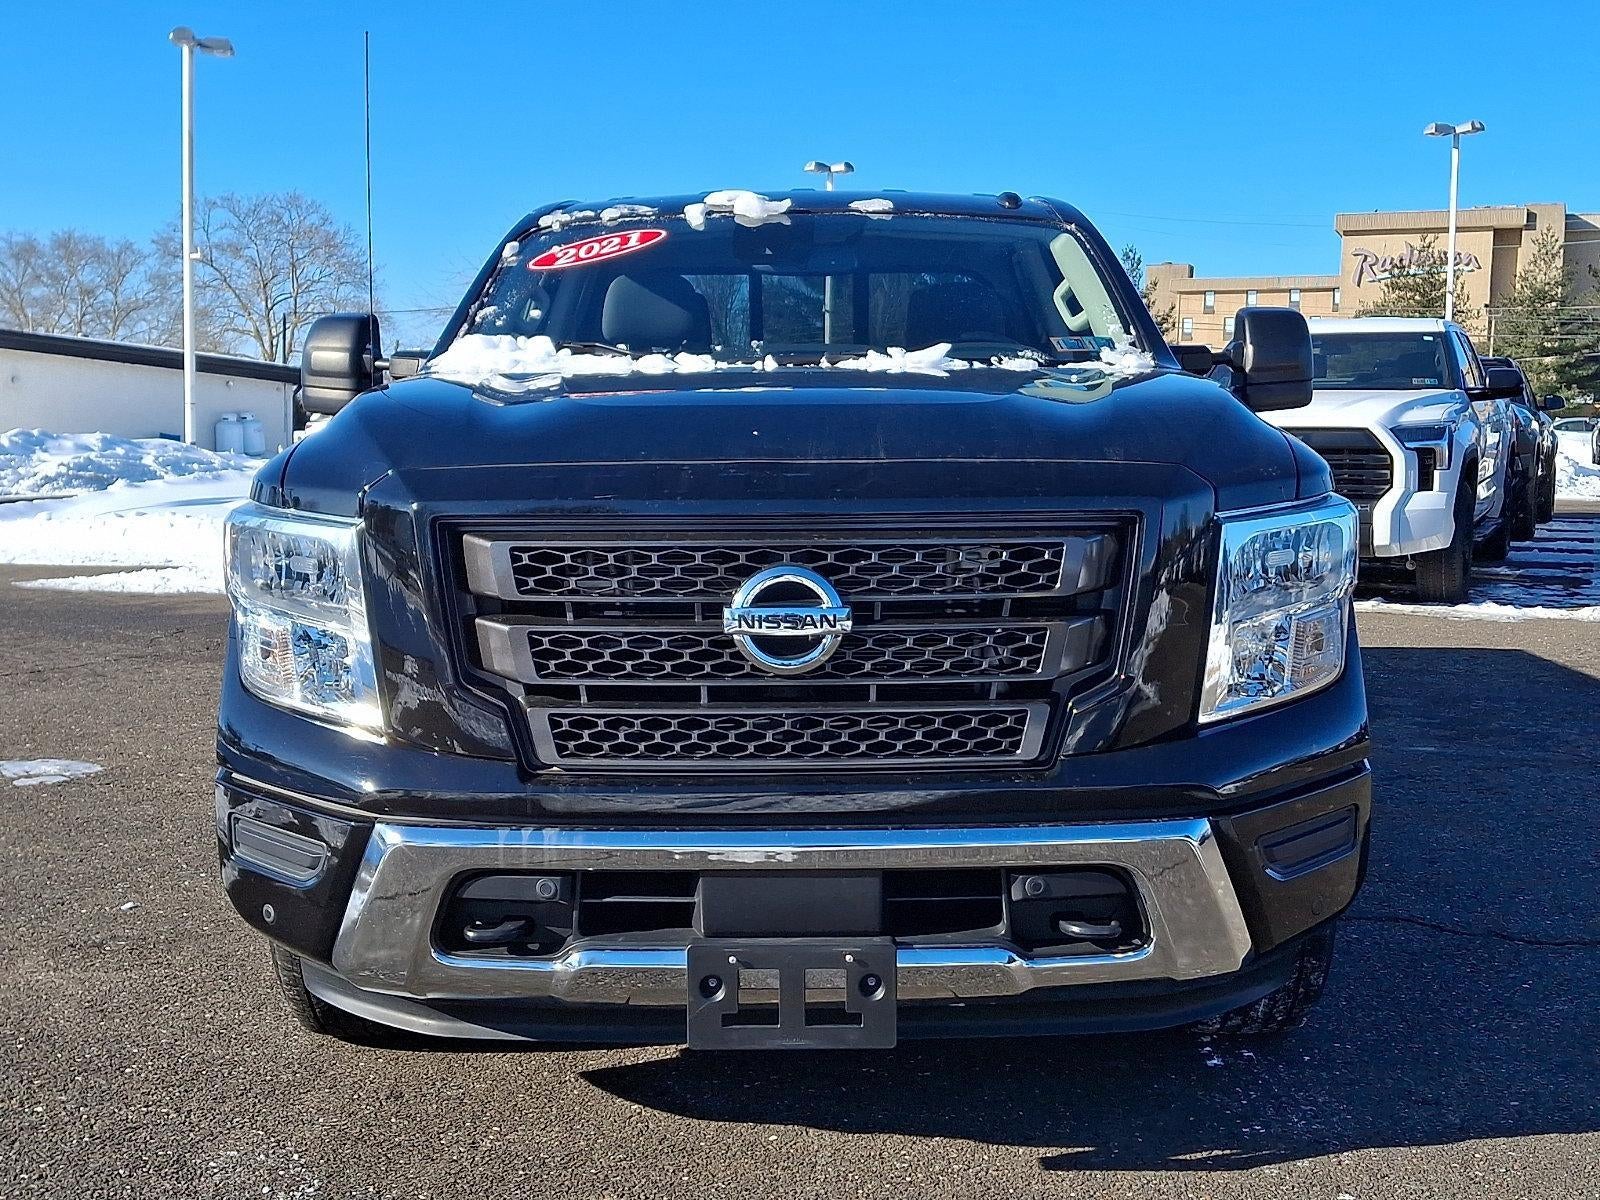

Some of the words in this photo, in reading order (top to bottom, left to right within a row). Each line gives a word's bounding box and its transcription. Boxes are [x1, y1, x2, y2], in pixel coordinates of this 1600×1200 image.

[554, 232, 640, 266] 2021
[1351, 240, 1482, 288] Radison
[737, 613, 837, 630] NISSAN
